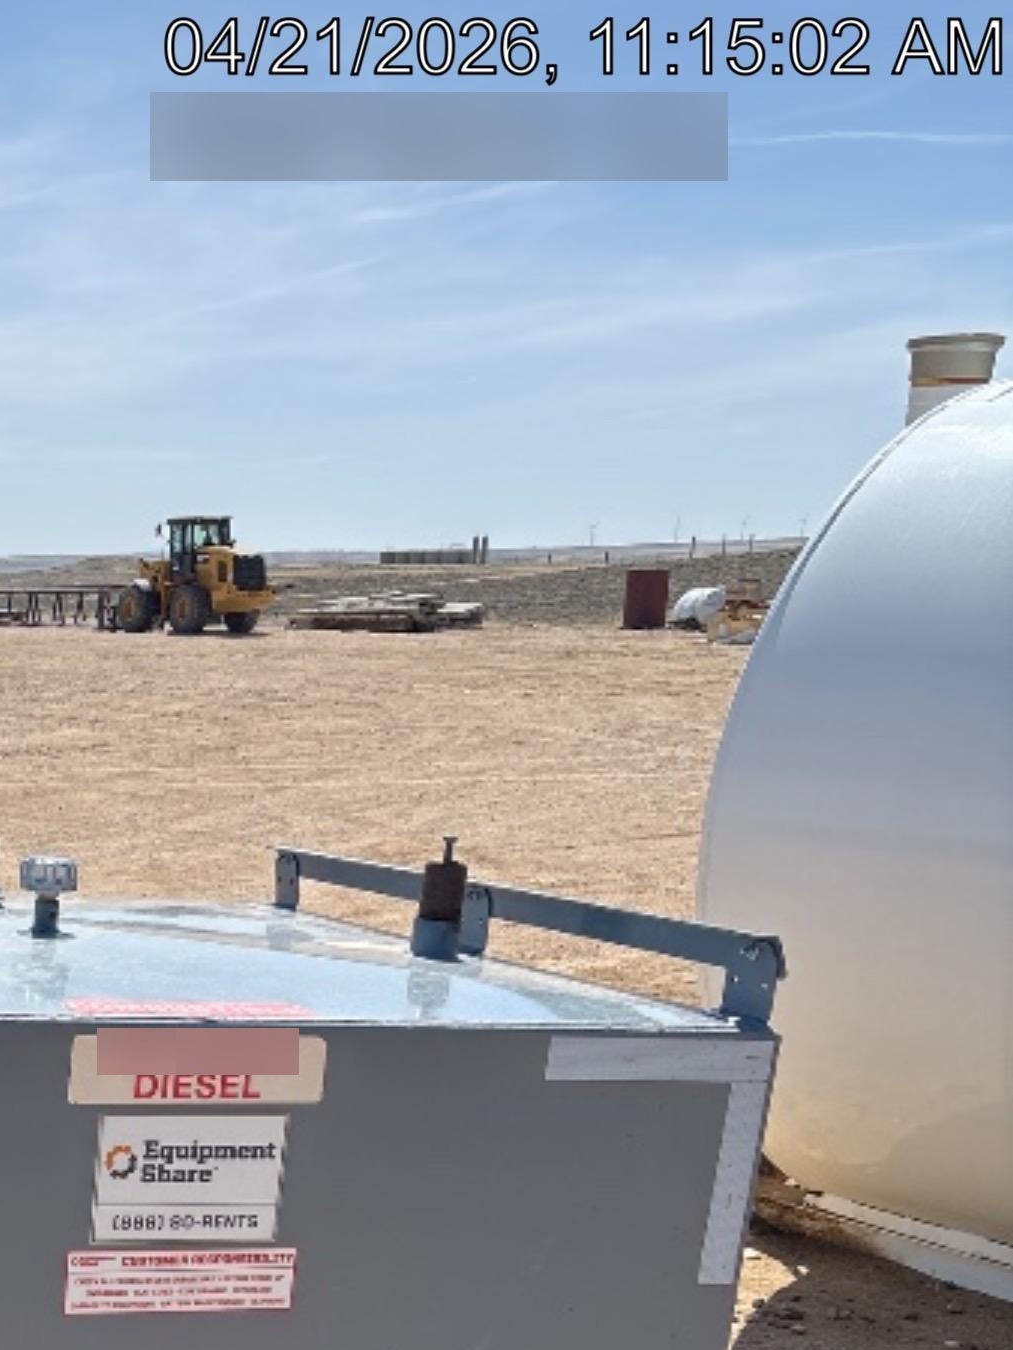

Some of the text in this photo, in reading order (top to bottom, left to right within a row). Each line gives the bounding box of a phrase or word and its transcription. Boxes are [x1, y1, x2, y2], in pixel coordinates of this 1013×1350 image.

[133, 1074, 261, 1099] DIESEL
[142, 1139, 277, 1164] Equipment
[140, 1163, 213, 1183] Share
